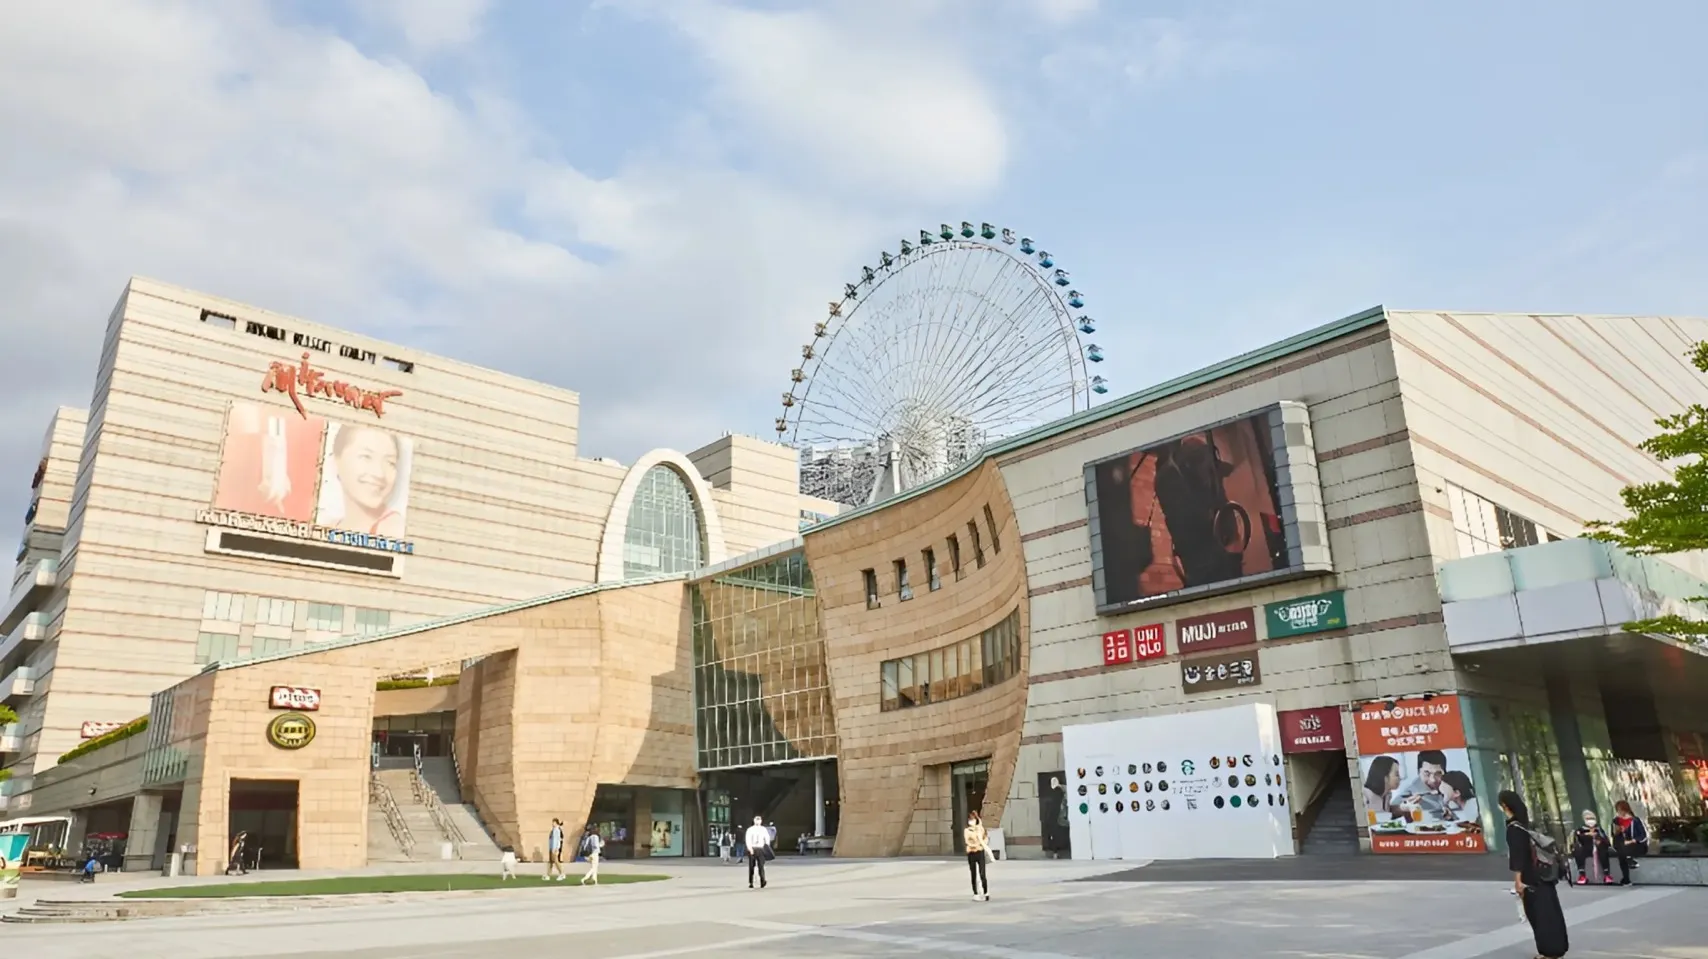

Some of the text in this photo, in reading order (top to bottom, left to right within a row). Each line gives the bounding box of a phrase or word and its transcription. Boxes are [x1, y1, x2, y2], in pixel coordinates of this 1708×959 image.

[1137, 628, 1158, 642] UNI
[1182, 622, 1217, 644] MUJI
[1138, 641, 1162, 656] QLO
